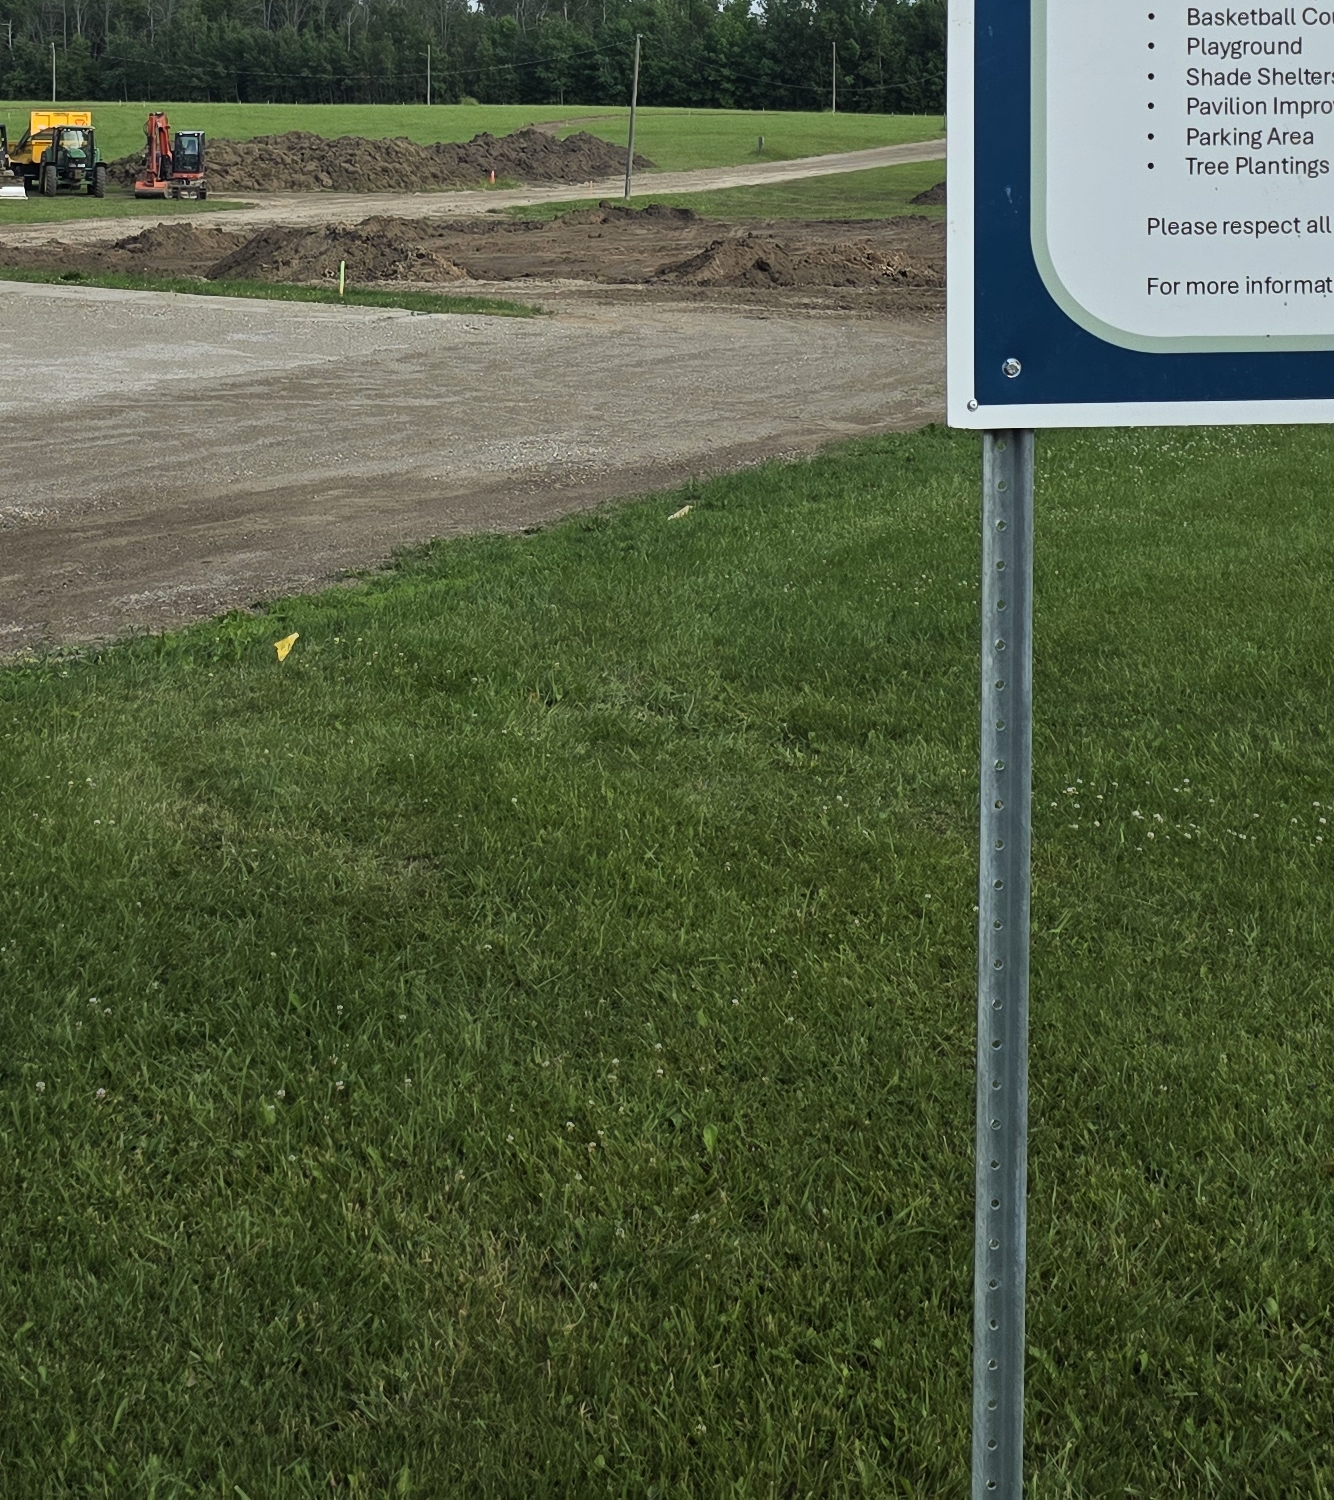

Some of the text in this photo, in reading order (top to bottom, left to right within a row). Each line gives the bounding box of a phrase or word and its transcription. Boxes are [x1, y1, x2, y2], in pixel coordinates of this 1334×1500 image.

[1187, 7, 1297, 27] Basketball
[1187, 36, 1303, 60] Playground
[1186, 67, 1252, 87] Shade
[1187, 96, 1267, 116] Pavilion
[1186, 126, 1314, 150] Parking Area
[1184, 155, 1330, 179] Tree Plantings
[1147, 217, 1218, 236] Please
[1222, 217, 1302, 239] respect
[1306, 215, 1332, 234] all
[1147, 277, 1181, 296] For
[1186, 280, 1240, 296] more
